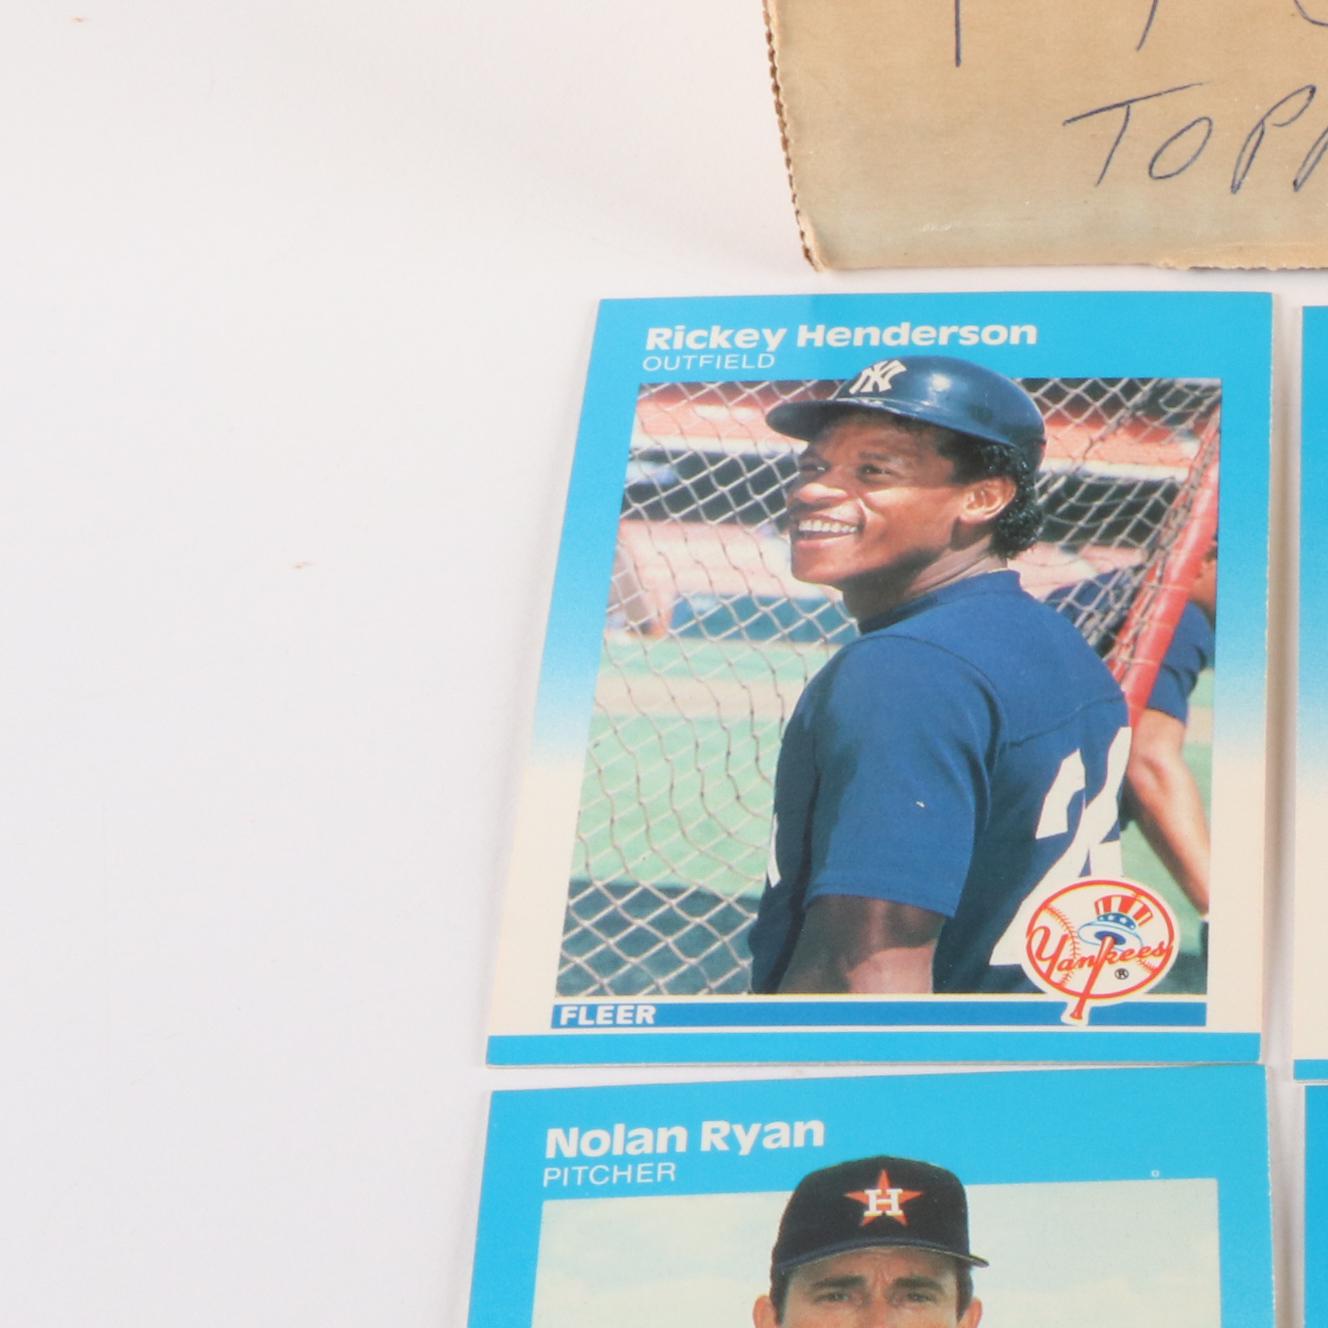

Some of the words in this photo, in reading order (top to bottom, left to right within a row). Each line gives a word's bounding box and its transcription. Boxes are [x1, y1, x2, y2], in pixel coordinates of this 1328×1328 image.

[644, 326, 787, 352] Rickey
[796, 322, 1038, 348] Henderson
[642, 353, 776, 372] OUTFIELD
[1027, 925, 1173, 979] Yankees
[559, 1004, 656, 1026] FLEER
[545, 1123, 688, 1158] Nolan
[701, 1119, 825, 1155] Ryan
[541, 1162, 677, 1188] PITCHER
[864, 1188, 903, 1217] H
